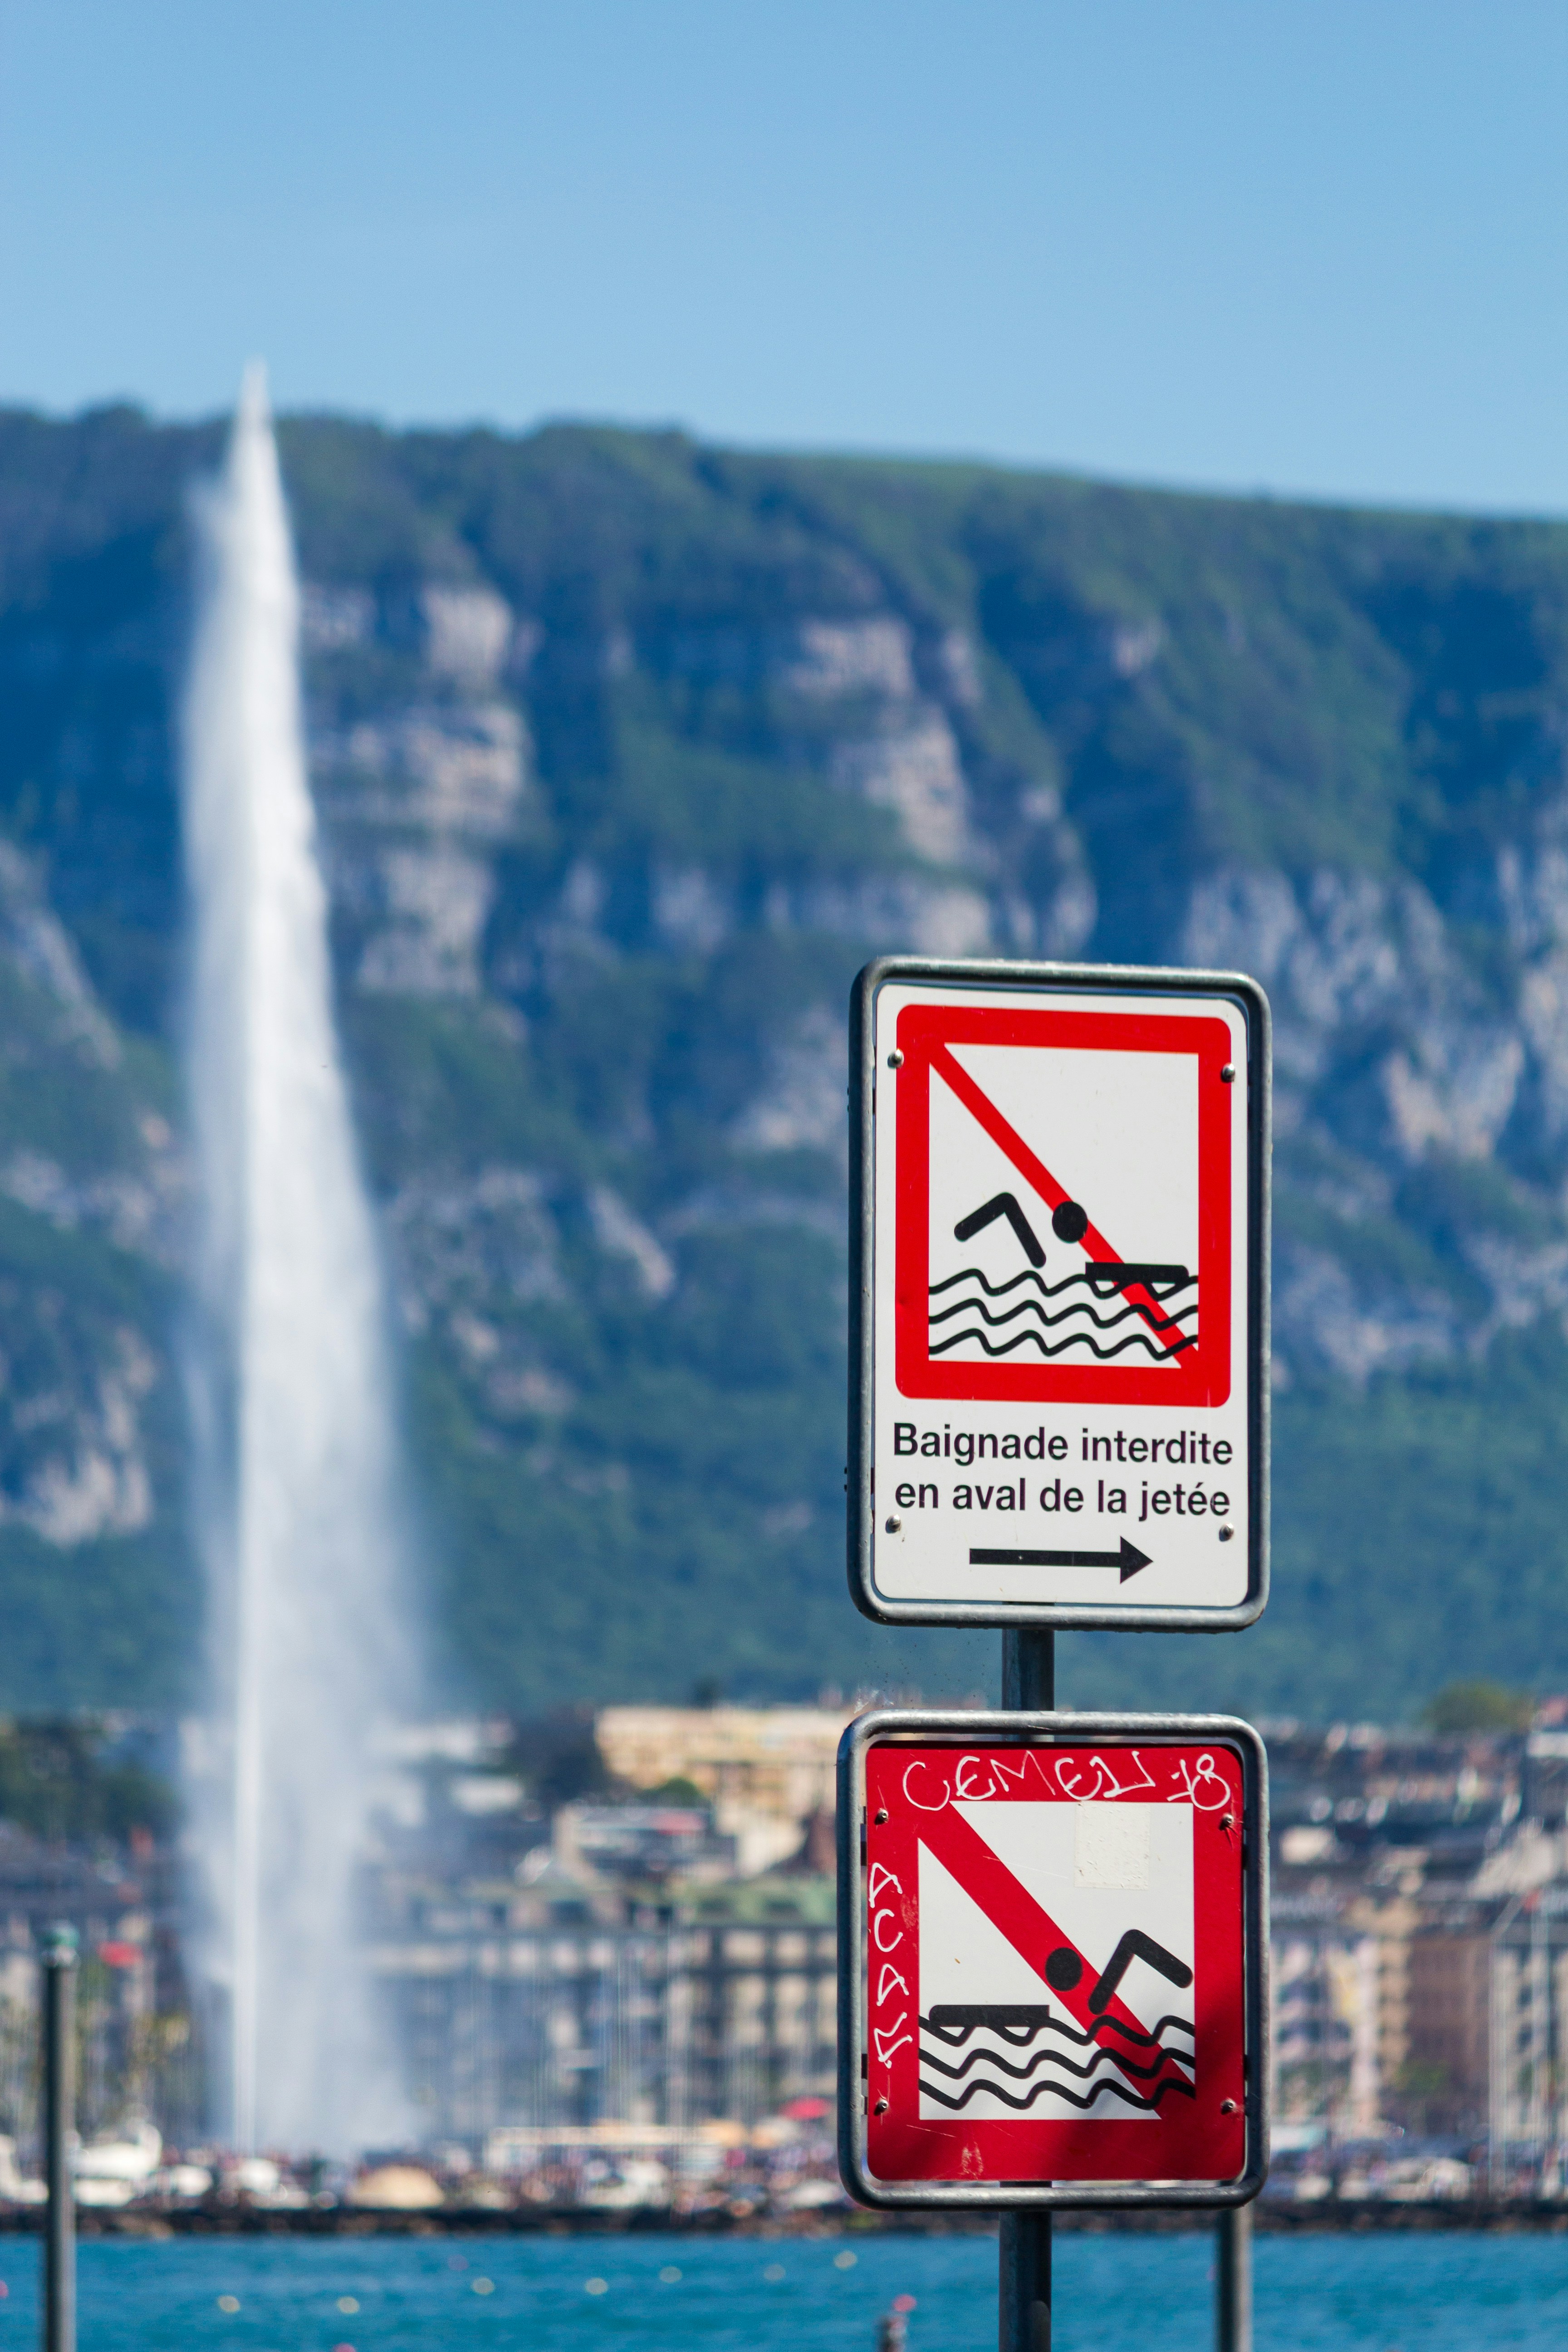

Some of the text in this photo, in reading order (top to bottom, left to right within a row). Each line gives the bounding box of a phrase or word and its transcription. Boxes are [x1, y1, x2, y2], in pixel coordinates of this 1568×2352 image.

[894, 1422, 1233, 1466] Baignade interdite
[895, 1478, 1230, 1522] en aval de la jetée
